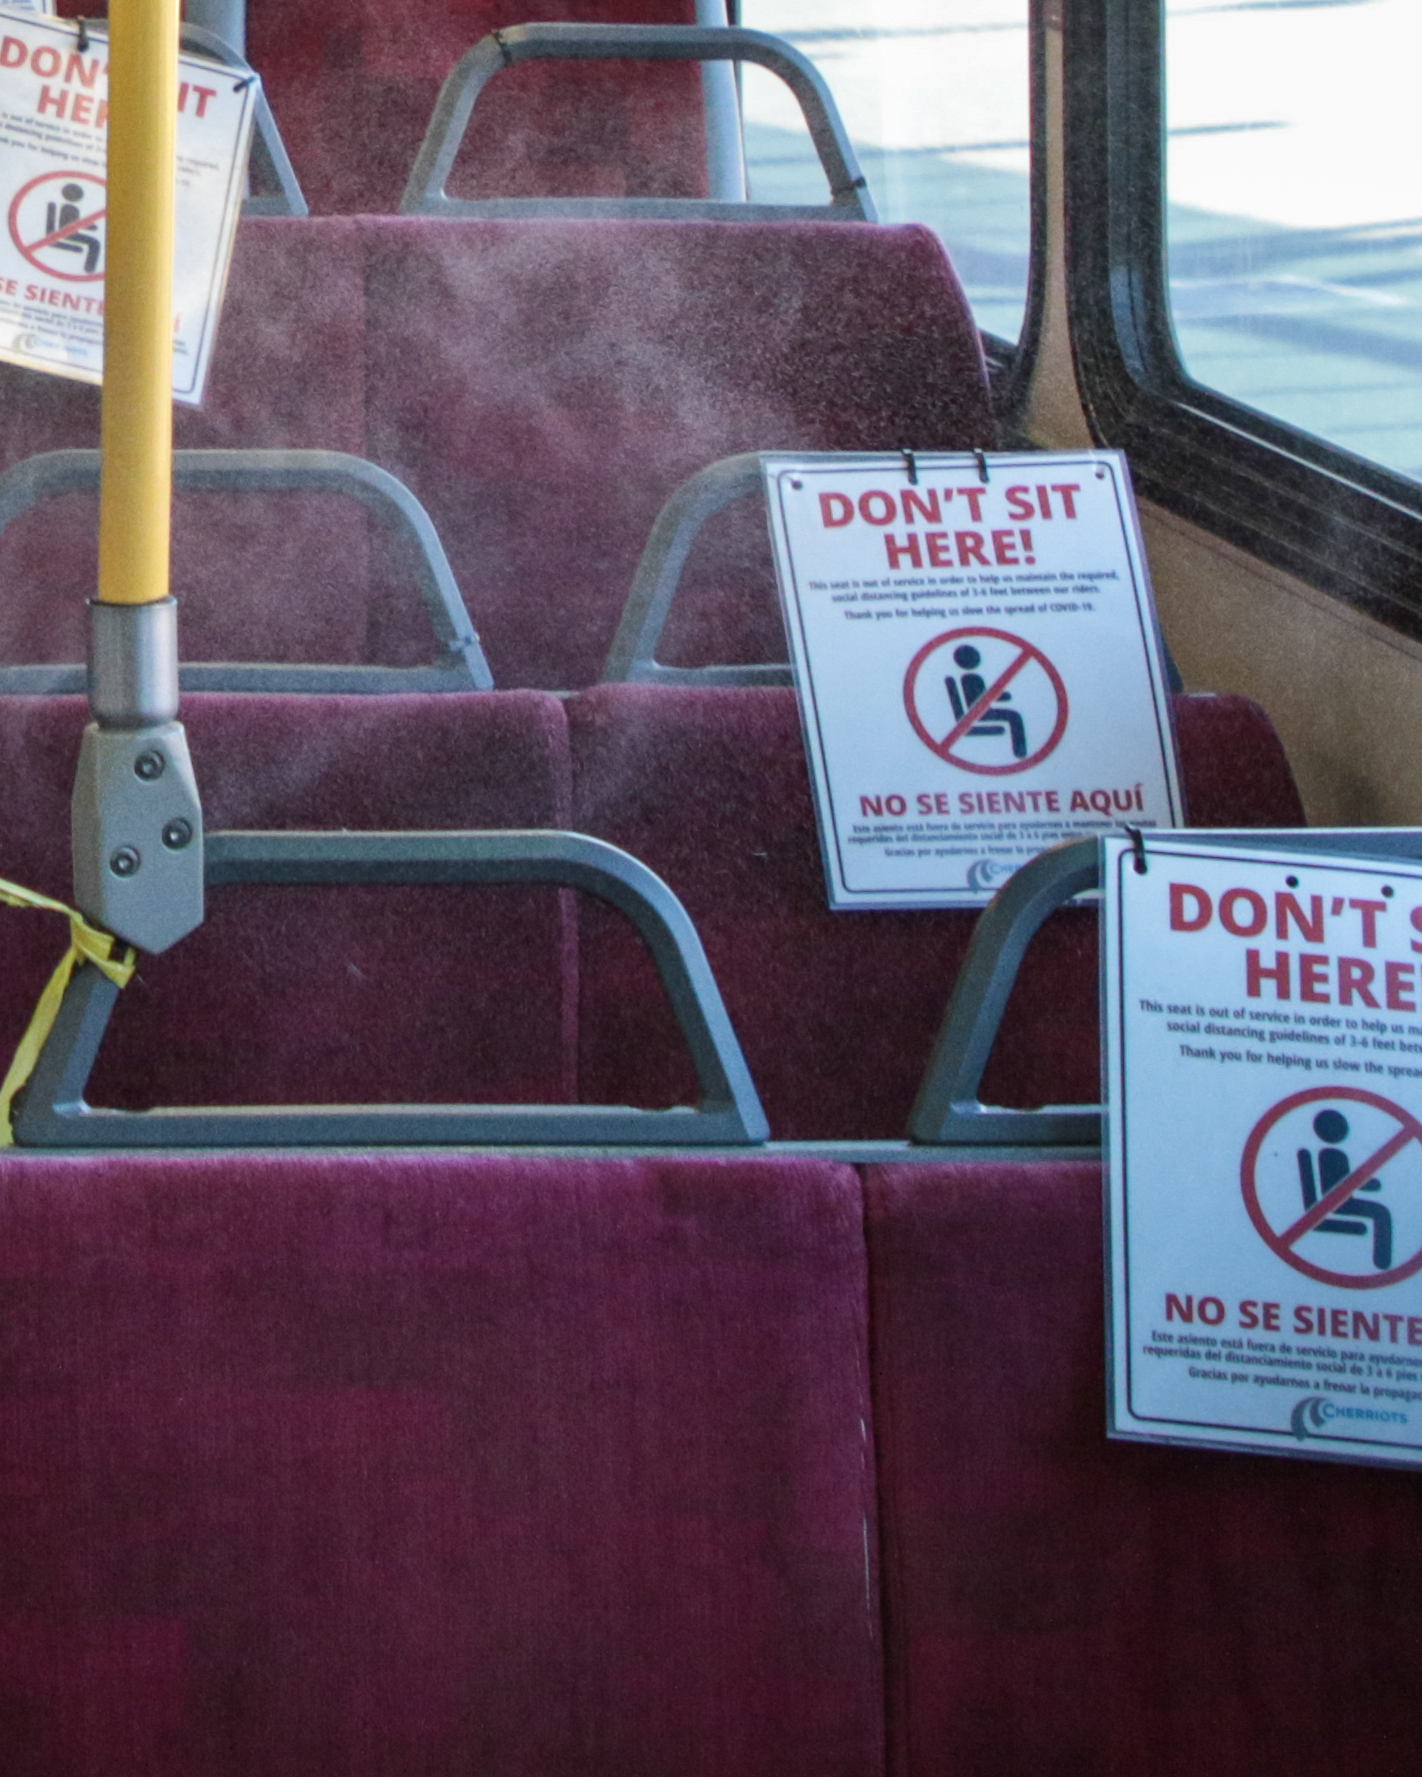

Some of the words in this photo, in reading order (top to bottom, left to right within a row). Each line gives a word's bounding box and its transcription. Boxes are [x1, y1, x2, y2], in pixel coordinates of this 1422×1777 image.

[178, 82, 217, 119] IT
[818, 487, 987, 528] DON'T
[1005, 484, 1082, 520] SIT
[884, 529, 1037, 570] HERE!
[859, 793, 908, 818] NO
[916, 792, 951, 816] SE
[958, 789, 1061, 815] SIENTE
[1069, 782, 1145, 816] AQUÍ
[1169, 882, 1387, 949] DON'T
[1245, 947, 1422, 1013] HERE
[1139, 999, 1164, 1013] This
[1167, 1003, 1192, 1015] seat
[1196, 1003, 1206, 1017] is
[1209, 1007, 1229, 1019] out
[1233, 1006, 1246, 1020] of
[1249, 1008, 1290, 1023] service
[1294, 1012, 1306, 1025] in
[1309, 1013, 1341, 1029] order
[1345, 1018, 1358, 1030] to
[1361, 1017, 1388, 1035] help
[1391, 1023, 1405, 1034] us
[1166, 1021, 1201, 1034] social
[1204, 1021, 1265, 1042] distancing
[1269, 1028, 1330, 1045] guidelines
[1334, 1032, 1346, 1046] of
[1350, 1034, 1369, 1049] 3-6
[1372, 1035, 1396, 1052] feet
[1180, 1044, 1217, 1060] Thank
[1220, 1049, 1243, 1064] you
[1246, 1049, 1264, 1063] for
[1266, 1051, 1312, 1071] helping
[1315, 1058, 1329, 1069] us
[1333, 1057, 1361, 1072] slow
[1364, 1060, 1384, 1075] the
[1164, 1292, 1226, 1326] NO
[1238, 1298, 1282, 1333] SE
[1293, 1304, 1422, 1346] SIENTE
[1323, 1402, 1409, 1424] CHERRIOTS
